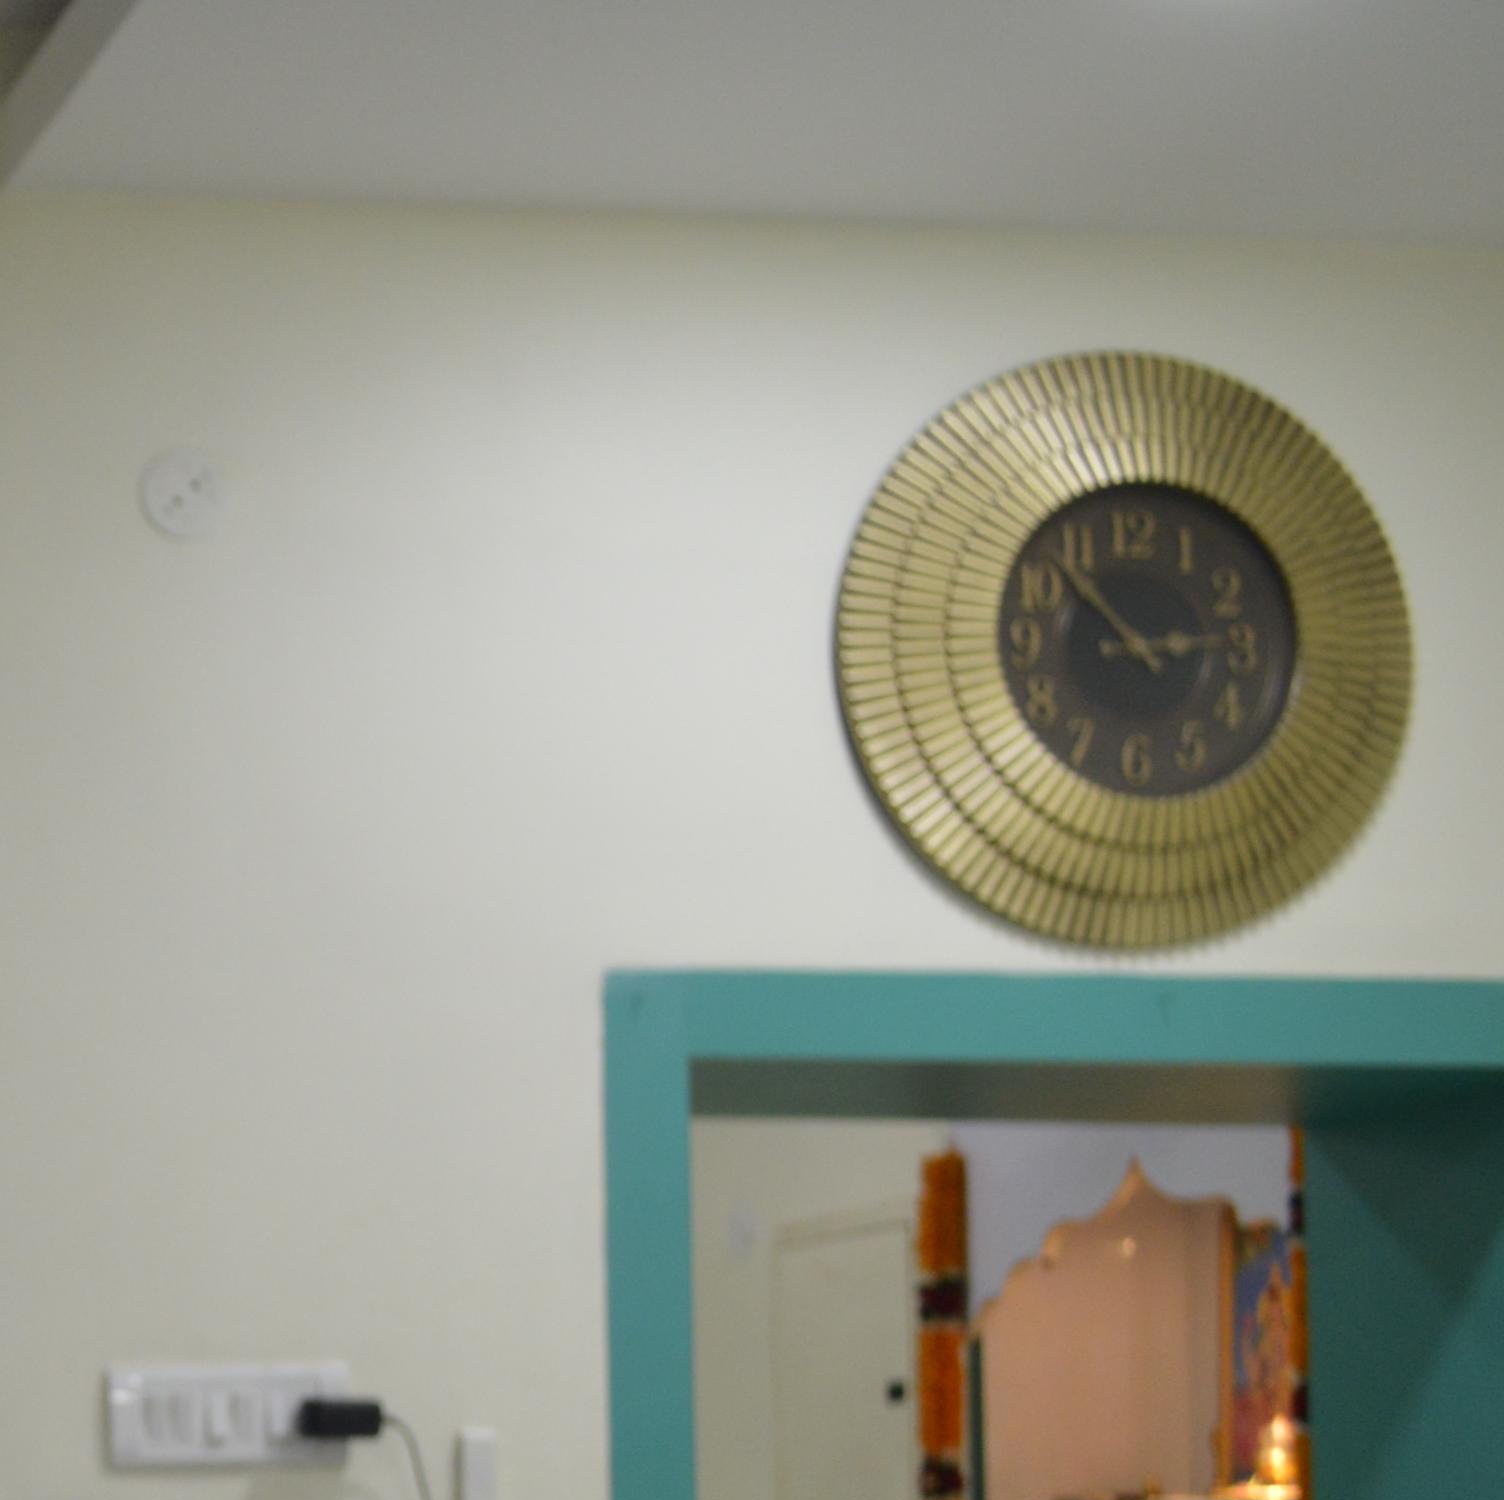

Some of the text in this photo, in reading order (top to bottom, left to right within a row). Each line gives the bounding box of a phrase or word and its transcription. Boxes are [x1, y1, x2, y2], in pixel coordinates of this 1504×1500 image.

[1063, 521, 1092, 571] 11
[1111, 511, 1157, 559] 12
[1179, 526, 1194, 575] 1
[1021, 560, 1063, 614] 10
[1212, 568, 1241, 618] 2
[1010, 617, 1040, 670] 9
[1227, 622, 1258, 674] 3
[1027, 675, 1058, 726] 8
[1213, 680, 1242, 730] 4
[1066, 716, 1094, 767] 7
[1121, 733, 1152, 785] 6
[1175, 720, 1206, 771] 5
